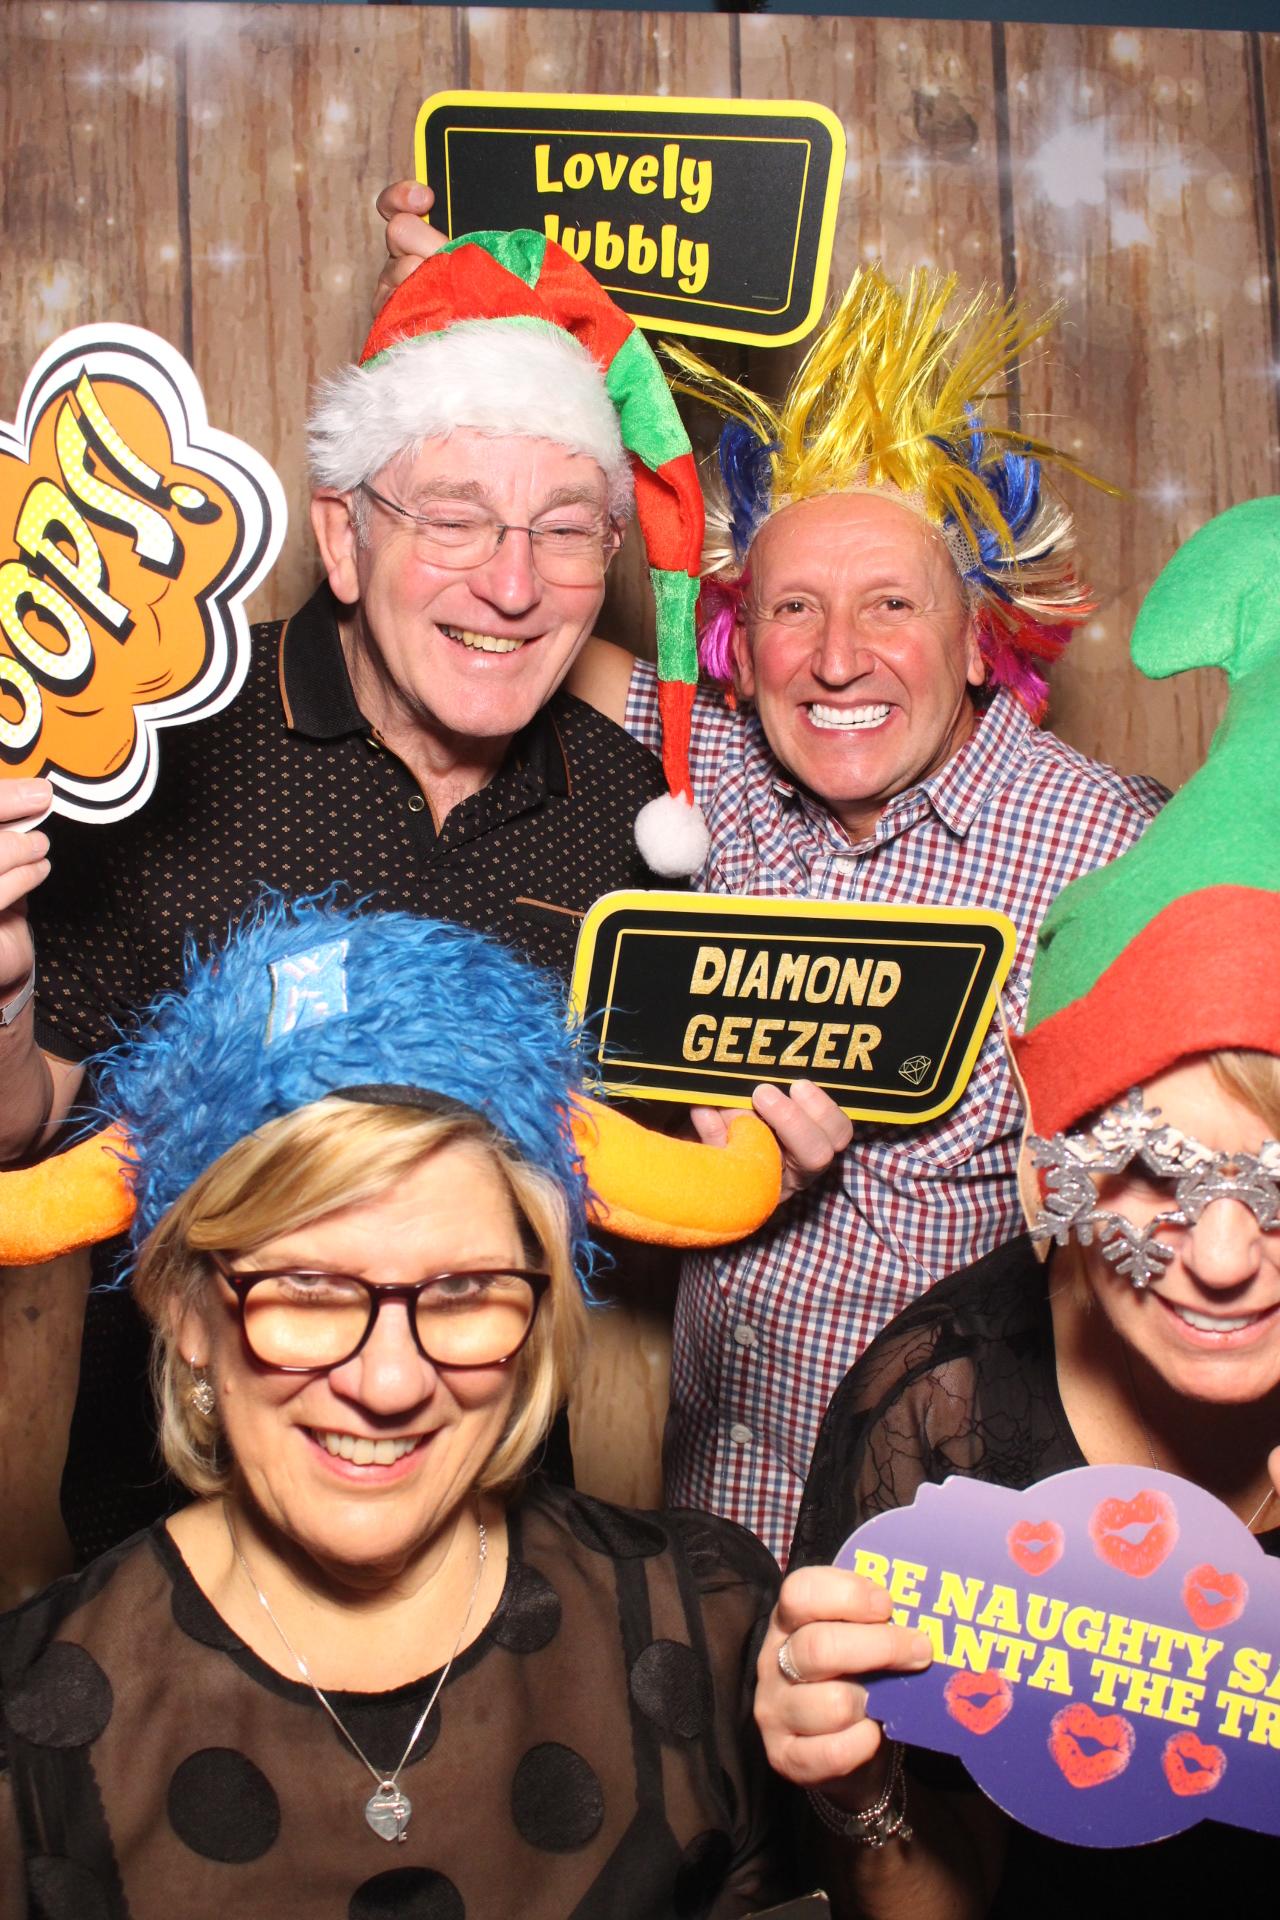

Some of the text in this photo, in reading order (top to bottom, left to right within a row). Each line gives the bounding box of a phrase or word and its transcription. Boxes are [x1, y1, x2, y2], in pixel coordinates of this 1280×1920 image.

[534, 143, 713, 214] Lovely
[689, 946, 902, 1008] DIAMOND
[681, 1014, 882, 1071] GEEZER
[932, 1570, 1224, 1681] NAUGHTY
[890, 1607, 1073, 1696] ANTA
[1090, 1657, 1206, 1728] THE
